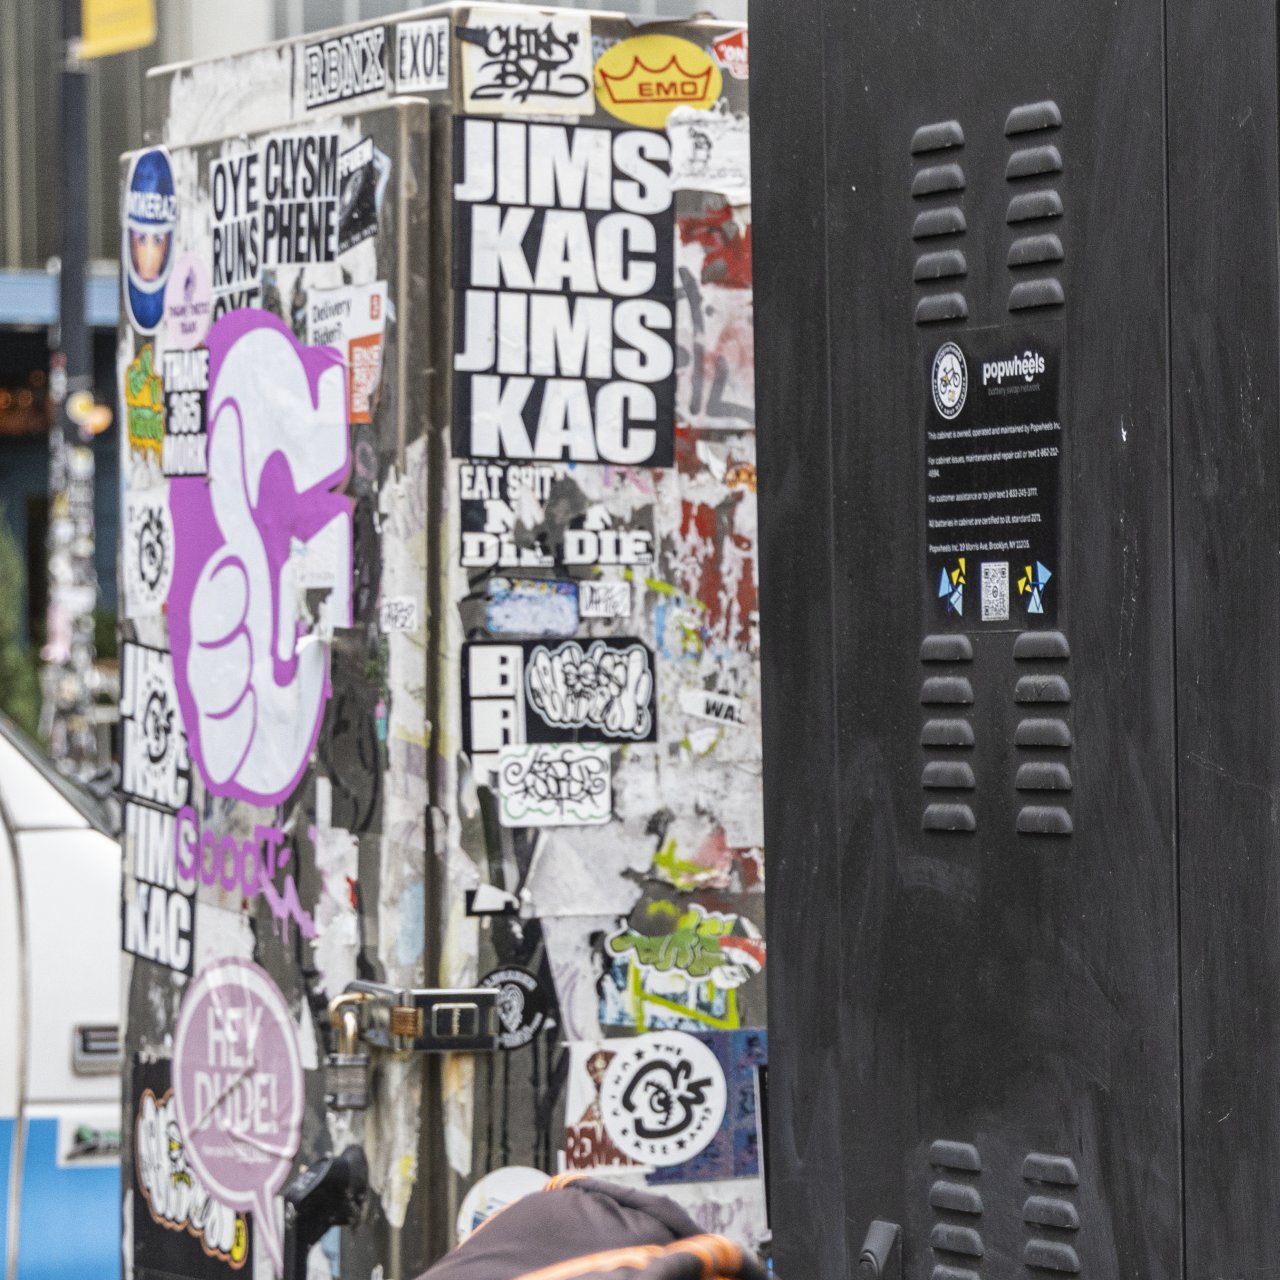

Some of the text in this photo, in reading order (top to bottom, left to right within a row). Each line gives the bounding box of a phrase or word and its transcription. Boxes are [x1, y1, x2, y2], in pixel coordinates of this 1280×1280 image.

[399, 24, 447, 84] EXOE
[638, 81, 699, 98] EMO
[213, 152, 259, 222] OYE
[264, 135, 339, 201] CLYSM
[454, 119, 674, 215] JIMS
[213, 217, 260, 288] RUNS
[262, 201, 337, 265] PHENE
[471, 204, 657, 297] KAC
[312, 299, 352, 325] Delivery
[454, 294, 674, 383] JIMS
[983, 351, 1046, 386] popwheels
[470, 376, 657, 464] KAC
[461, 466, 503, 500] EAT
[563, 529, 654, 566] DIE
[125, 879, 192, 972] KAC
[206, 1002, 262, 1068] HEY
[193, 1070, 280, 1137] DUDE!
